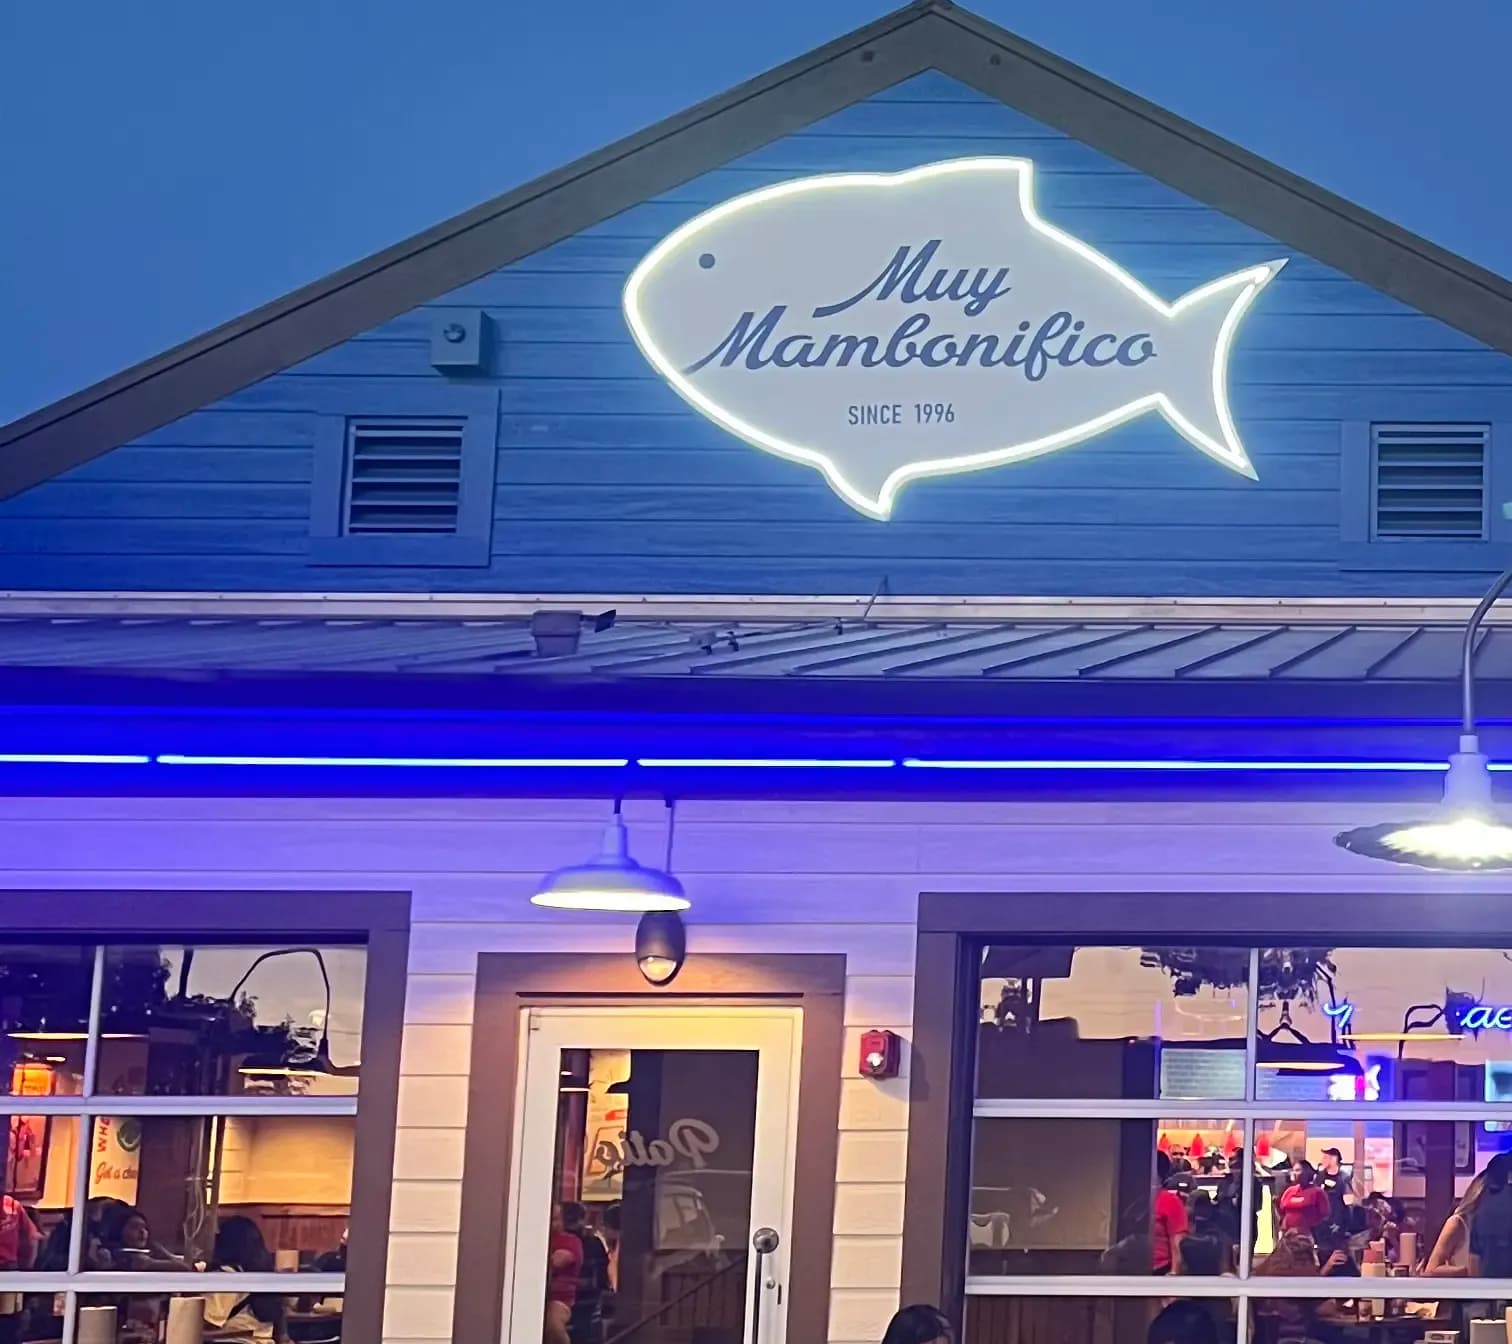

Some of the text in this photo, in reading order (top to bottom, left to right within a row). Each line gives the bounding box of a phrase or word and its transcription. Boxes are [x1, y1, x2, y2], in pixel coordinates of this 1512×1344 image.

[812, 238, 1013, 319] Muy
[682, 304, 1158, 383] Mambonifico
[847, 402, 956, 425] SINCE 1996
